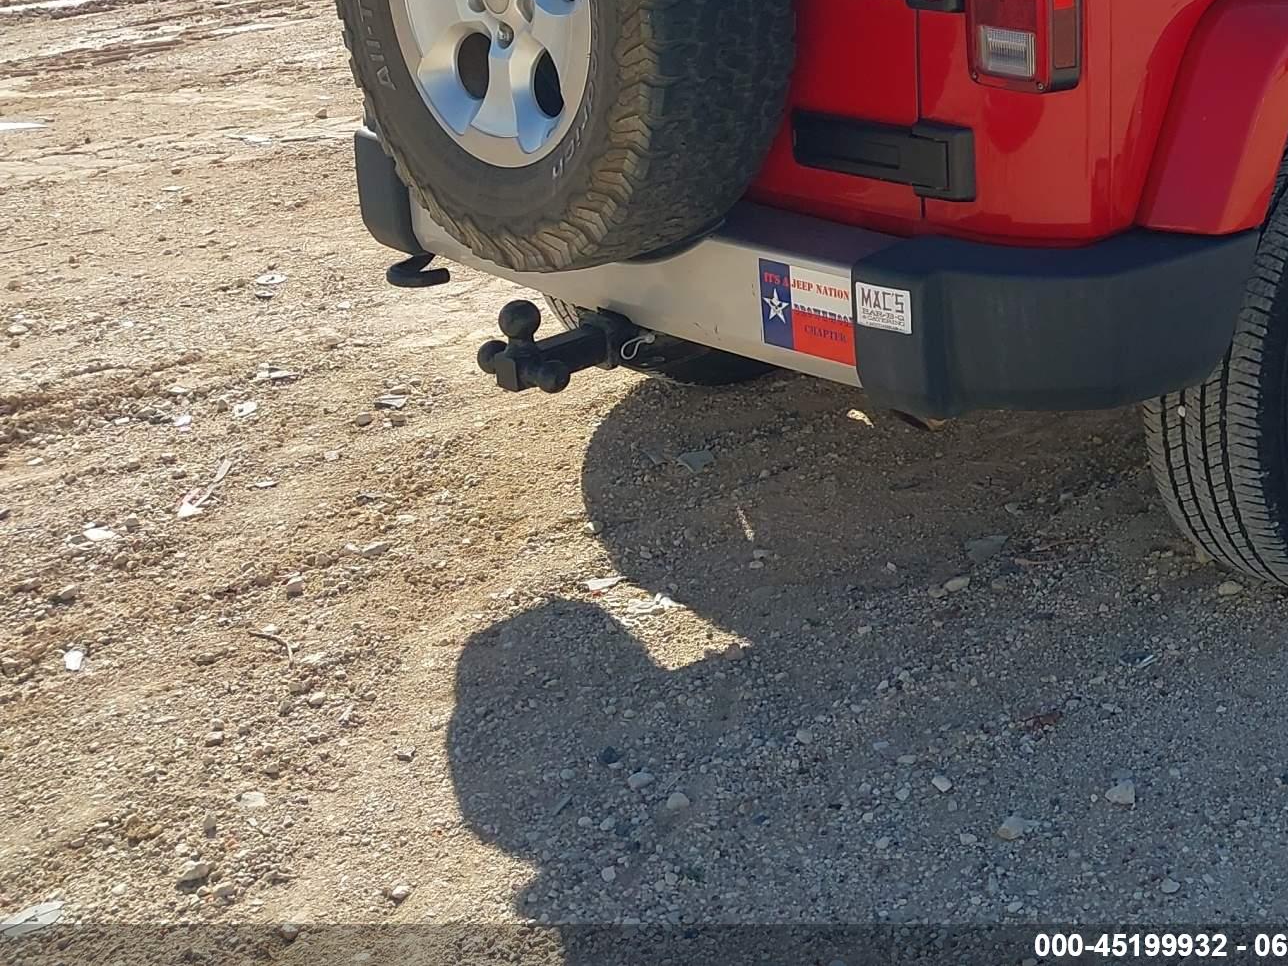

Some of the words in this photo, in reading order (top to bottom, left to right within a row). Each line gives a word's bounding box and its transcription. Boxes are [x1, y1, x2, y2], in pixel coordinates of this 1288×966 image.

[782, 275, 790, 288] A
[791, 278, 814, 292] JEEP
[815, 283, 849, 301] NATION
[860, 286, 905, 314] MAC'S
[804, 324, 847, 343] CHAPTER
